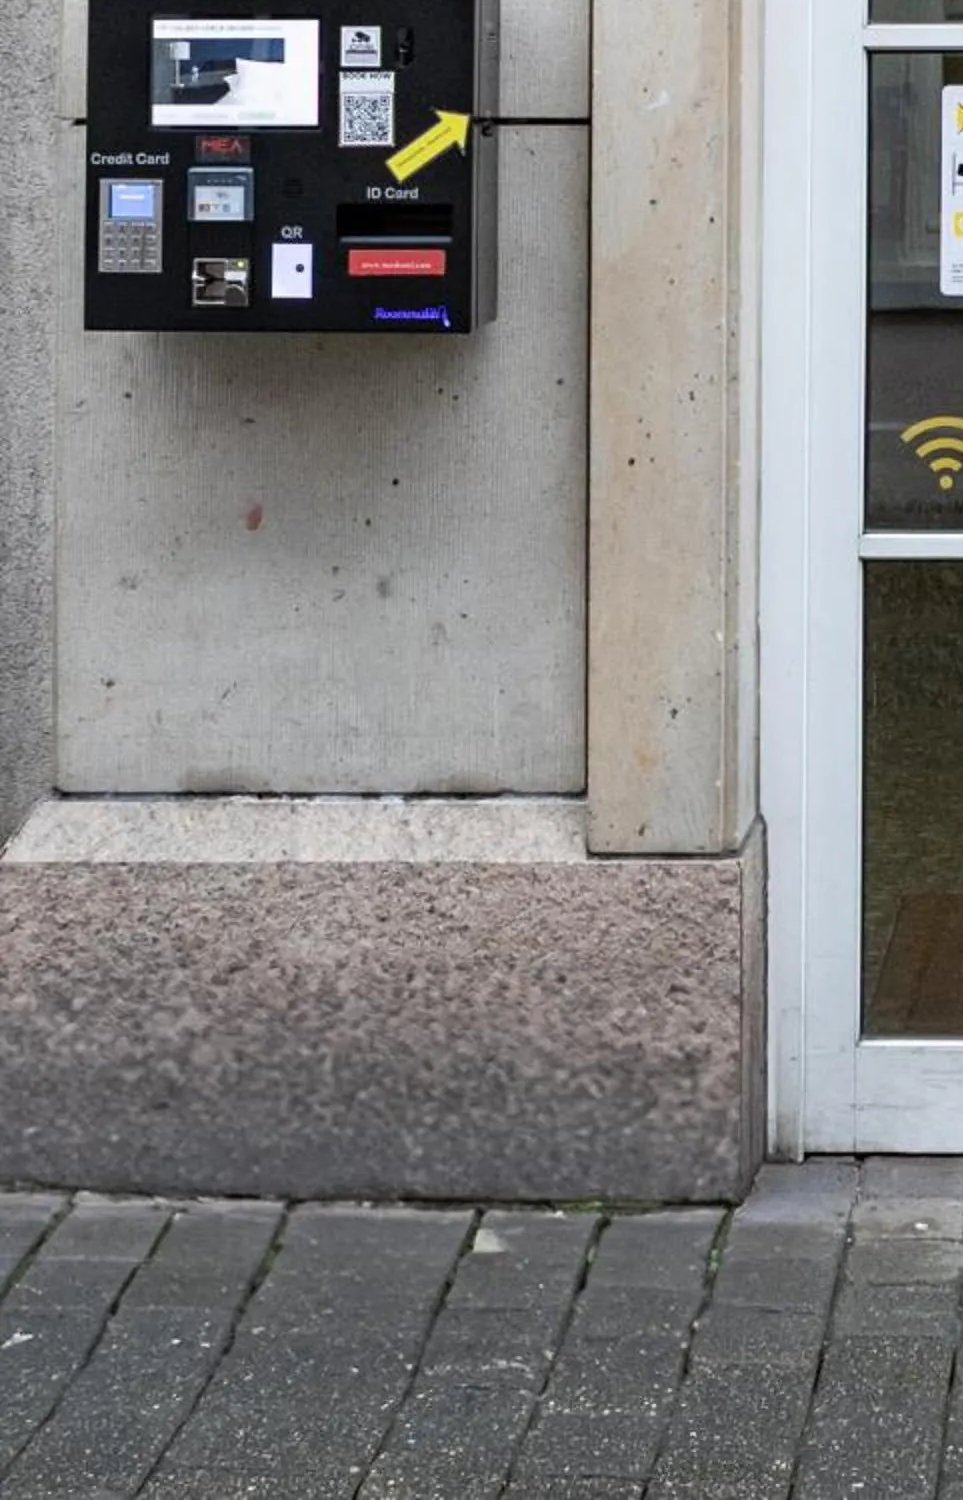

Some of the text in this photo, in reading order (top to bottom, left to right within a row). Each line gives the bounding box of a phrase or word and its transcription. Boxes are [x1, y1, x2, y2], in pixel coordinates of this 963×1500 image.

[90, 152, 170, 165] Credit Card
[366, 187, 419, 199] ID Card
[281, 226, 303, 239] QR
